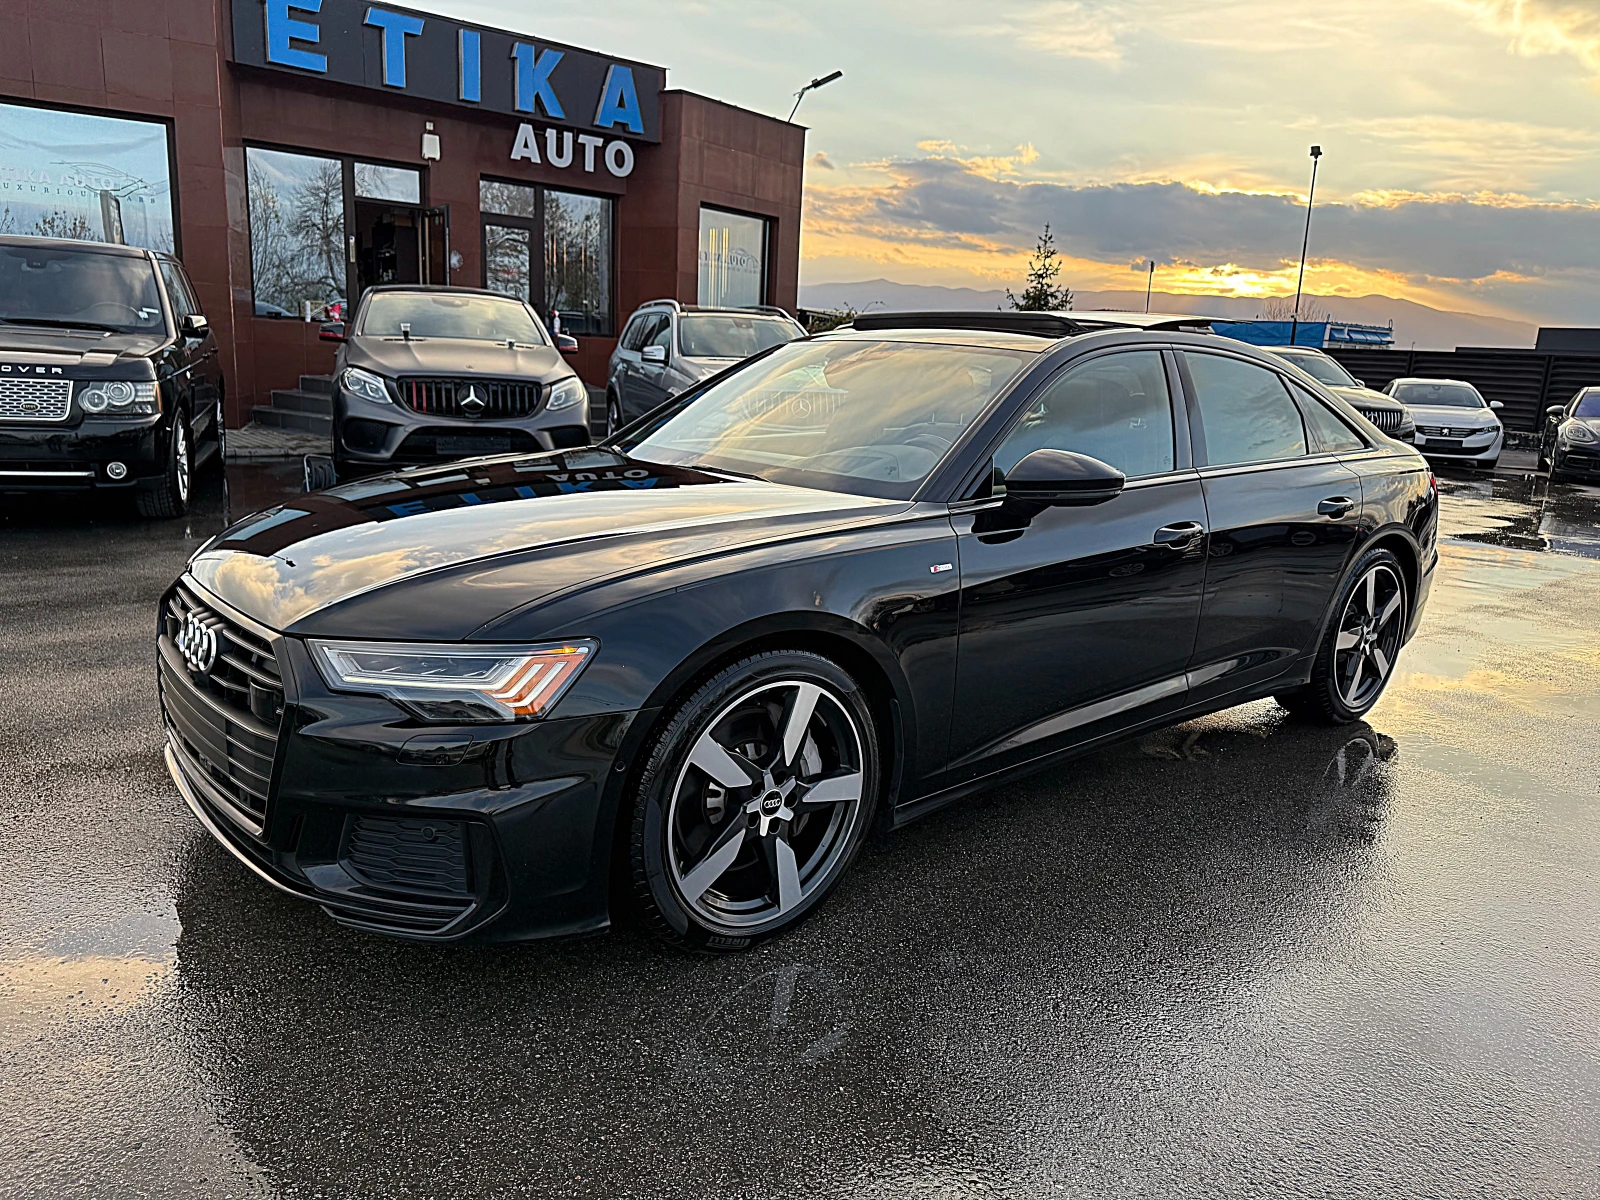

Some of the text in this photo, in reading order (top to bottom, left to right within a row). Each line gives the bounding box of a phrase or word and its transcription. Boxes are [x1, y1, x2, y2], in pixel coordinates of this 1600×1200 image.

[264, 0, 644, 134] ETIKA
[510, 123, 635, 178] AUTO
[0, 167, 52, 184] TIKA
[2, 182, 100, 198] UXURIOUS
[0, 365, 63, 375] OVER
